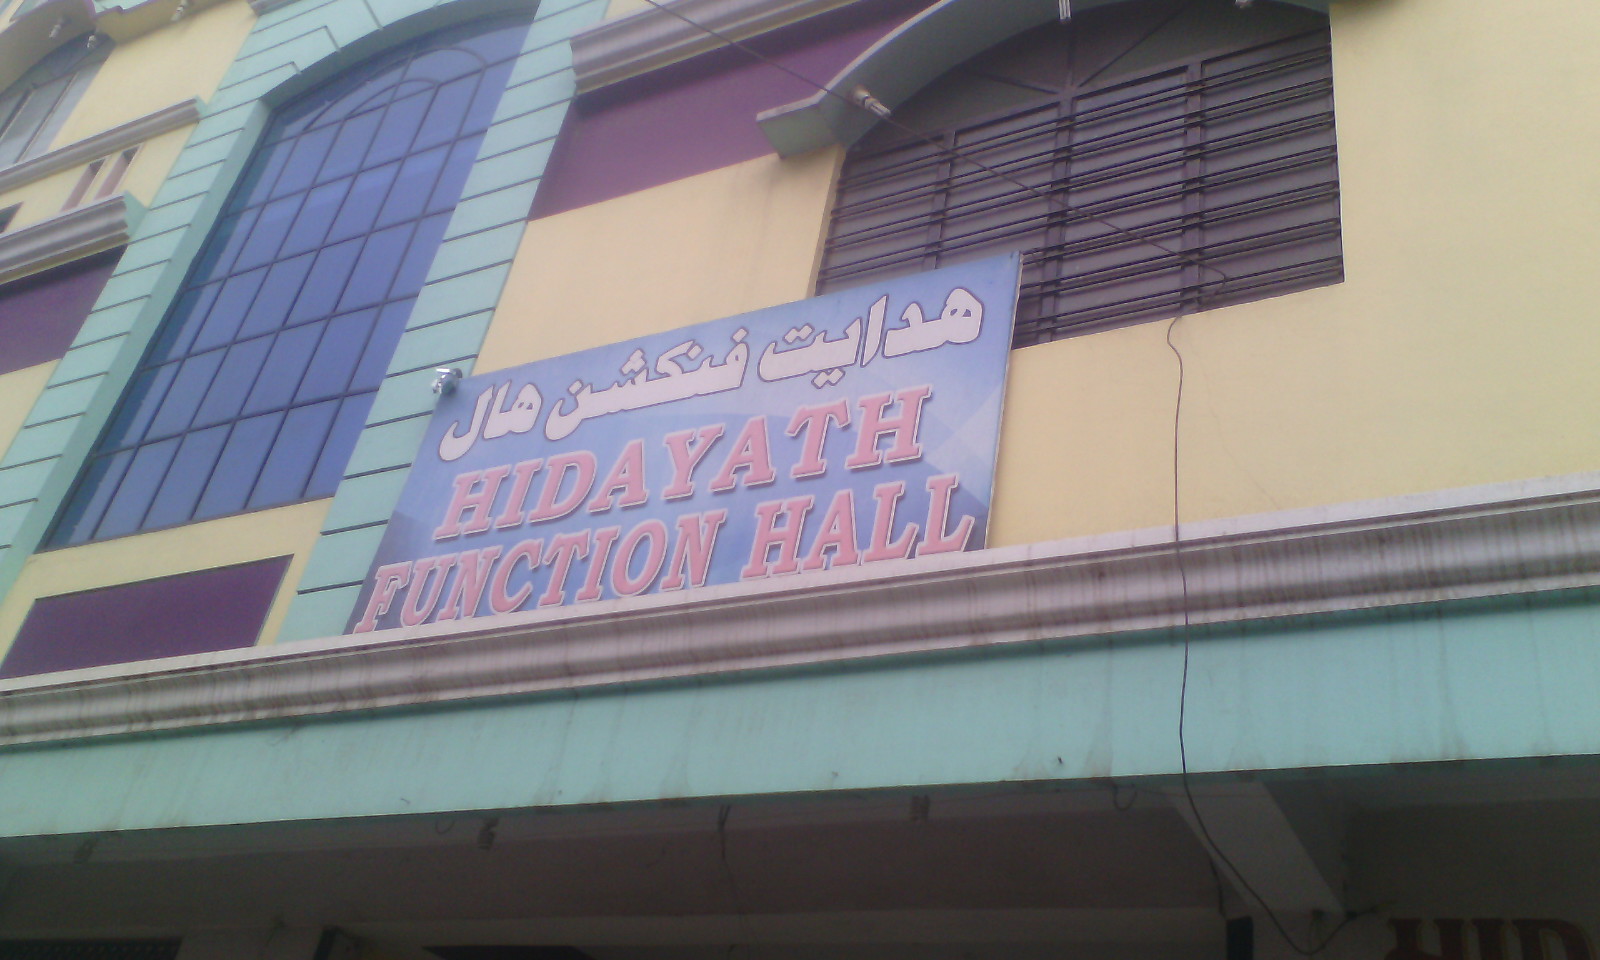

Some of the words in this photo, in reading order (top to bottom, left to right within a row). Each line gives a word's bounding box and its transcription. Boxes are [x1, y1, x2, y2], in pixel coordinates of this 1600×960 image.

[433, 385, 932, 541] HIDAYATH
[354, 509, 727, 633] FUNCTION
[741, 474, 975, 578] HALL
